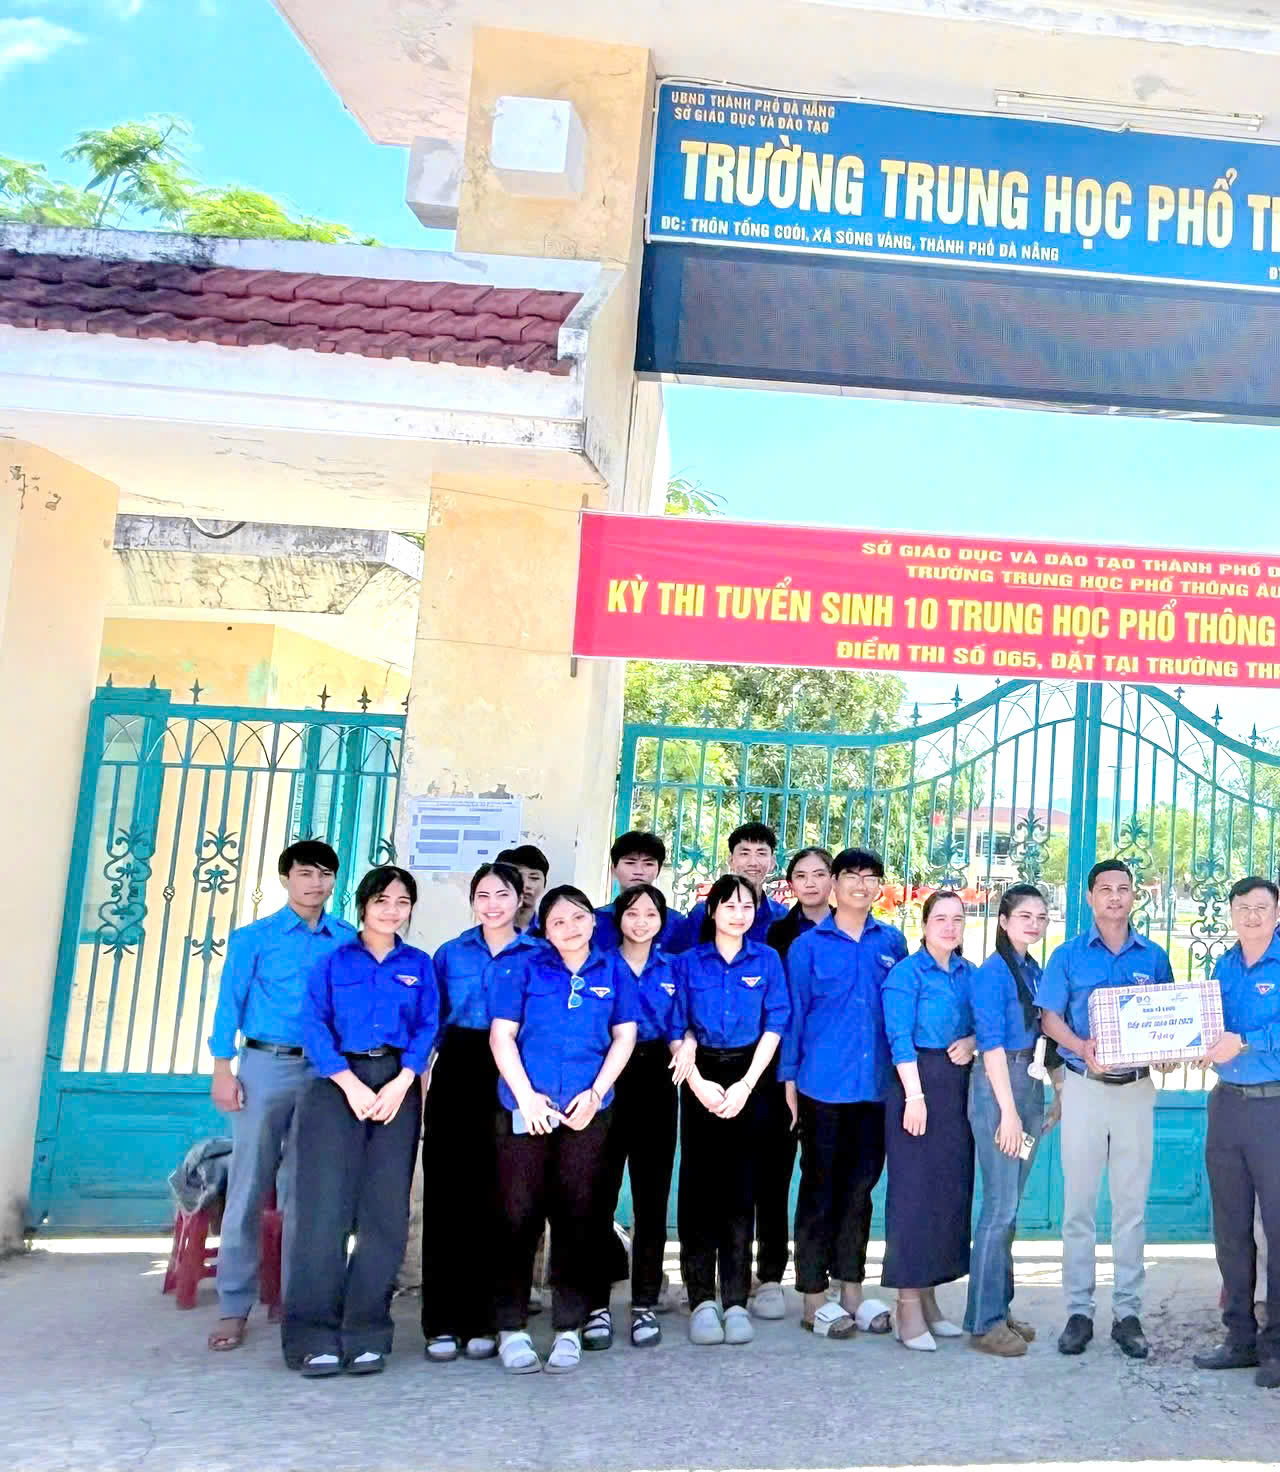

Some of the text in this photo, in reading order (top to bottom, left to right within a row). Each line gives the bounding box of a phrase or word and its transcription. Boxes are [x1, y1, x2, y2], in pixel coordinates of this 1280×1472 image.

[671, 91, 705, 105] UBND
[711, 94, 751, 111] THÀNH
[755, 97, 780, 113] PHỐ
[674, 104, 829, 135] SỞ GIÁO DỤC VÀ ĐÀO TẠO
[680, 134, 865, 218] TRƯỜNG
[880, 158, 1029, 232] TRUNG
[1044, 174, 1133, 251] HỌC
[1147, 167, 1239, 250] PHỔ
[661, 214, 686, 232] ĐC:
[690, 216, 729, 235] THÔN
[733, 217, 770, 238] TỐNG
[813, 226, 833, 244] XÃ
[835, 228, 872, 249] SÔNG
[877, 230, 917, 251] VÀNG,
[919, 234, 965, 255] THÀNH
[968, 237, 996, 258] PHỐ
[999, 240, 1018, 260] ĐÀ
[1021, 241, 1060, 262] NẴNG
[862, 540, 892, 557] SỞ
[900, 543, 951, 560] GIÁO
[958, 548, 1003, 565] DỤC
[1010, 550, 1038, 566] VÀ
[1044, 552, 1089, 568] ĐÀO
[1095, 555, 1136, 572] TẠO
[1142, 558, 1212, 576] THÀNH
[906, 563, 995, 584] TRƯỜNG
[1002, 569, 1074, 589] TRUNG
[1080, 574, 1124, 594] HỌC
[1180, 580, 1250, 598] THÔNG
[607, 574, 647, 613] KỲ
[658, 582, 705, 618] THI
[715, 576, 812, 623] TUYỂN
[820, 590, 895, 628] SINH
[904, 596, 938, 630] 10
[948, 599, 1043, 637] TRUNG
[1053, 603, 1109, 646] HỌC
[1119, 599, 1177, 642] PHỔ
[1184, 606, 1276, 649] THÔNG
[836, 637, 901, 663] ĐIỂM
[907, 643, 946, 666] THI
[953, 642, 987, 667] SỐ
[992, 648, 1043, 671] 065,
[1052, 651, 1096, 673] ĐẶT
[1103, 654, 1140, 675] TẠI
[1146, 653, 1239, 679] TRƯỜNG
